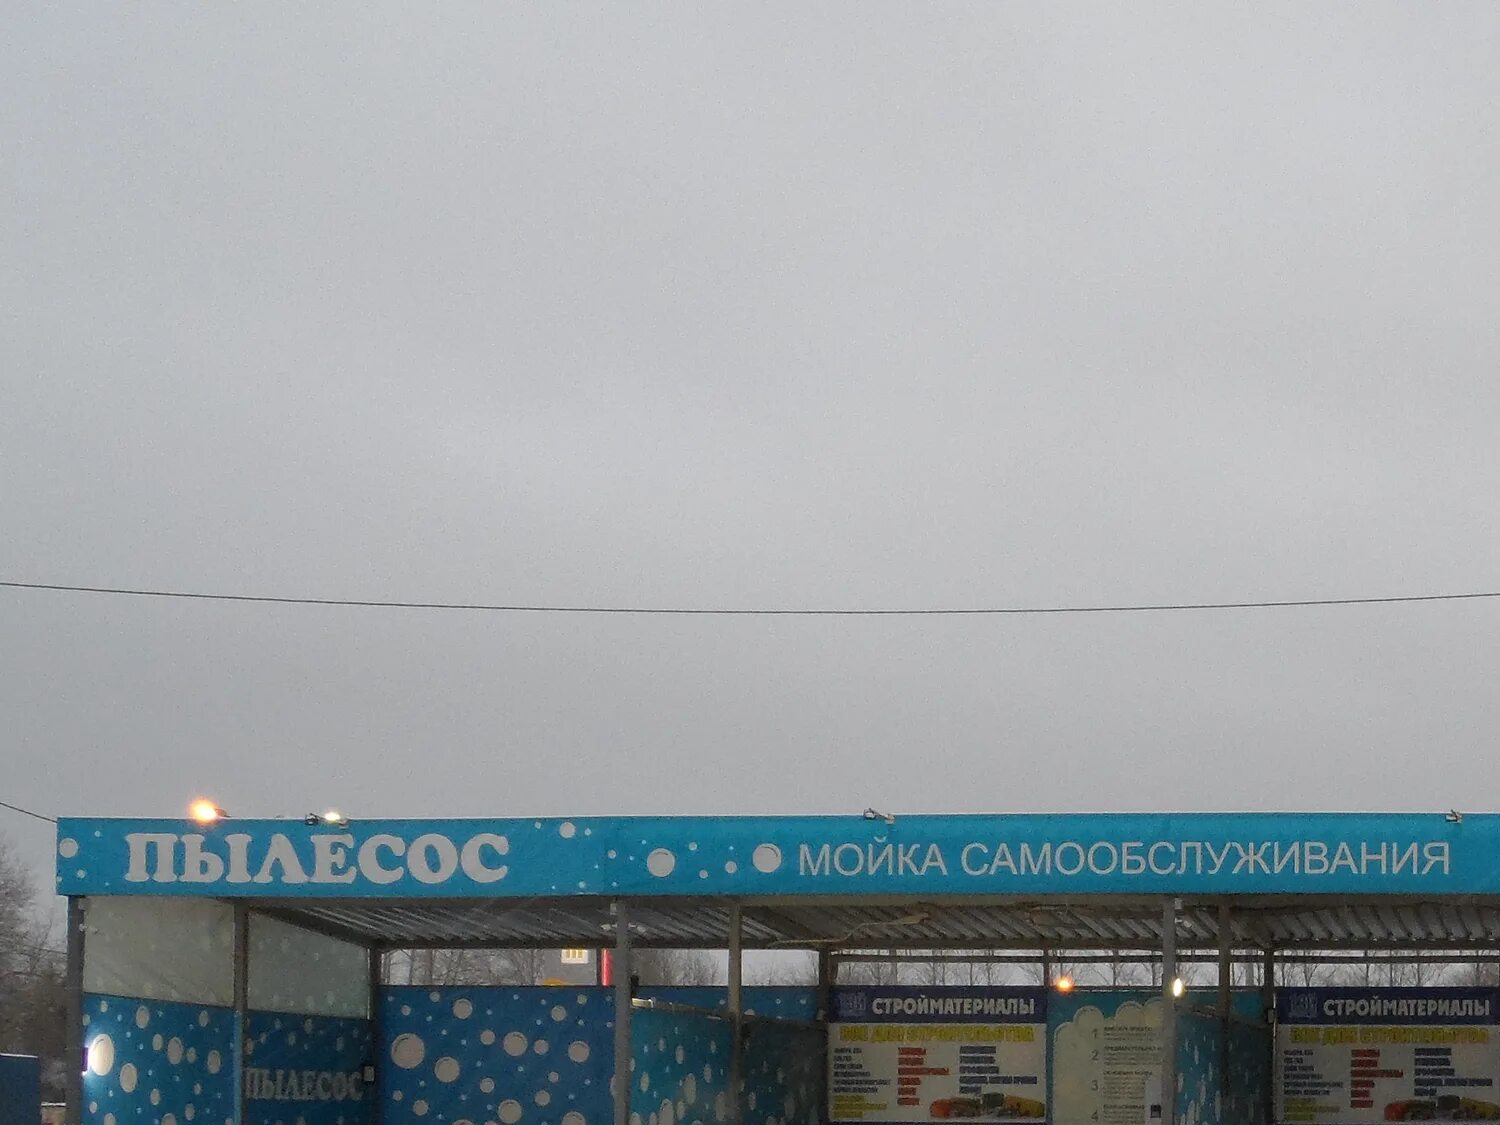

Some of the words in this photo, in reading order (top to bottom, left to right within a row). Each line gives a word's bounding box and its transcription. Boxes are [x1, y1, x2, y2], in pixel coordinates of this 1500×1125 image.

[124, 832, 510, 885] ПЫЛЕСОС
[799, 836, 948, 877] МОЙКА
[960, 840, 1451, 877] САМООБСЛУЖИВАНИЯ
[872, 994, 1035, 1015] СТРОЙМАТЕРИАЛЫ
[1323, 995, 1490, 1017] СТРОЙМАТЕРИАЛЫ
[245, 1067, 363, 1101] ПЫЛЕСОС
